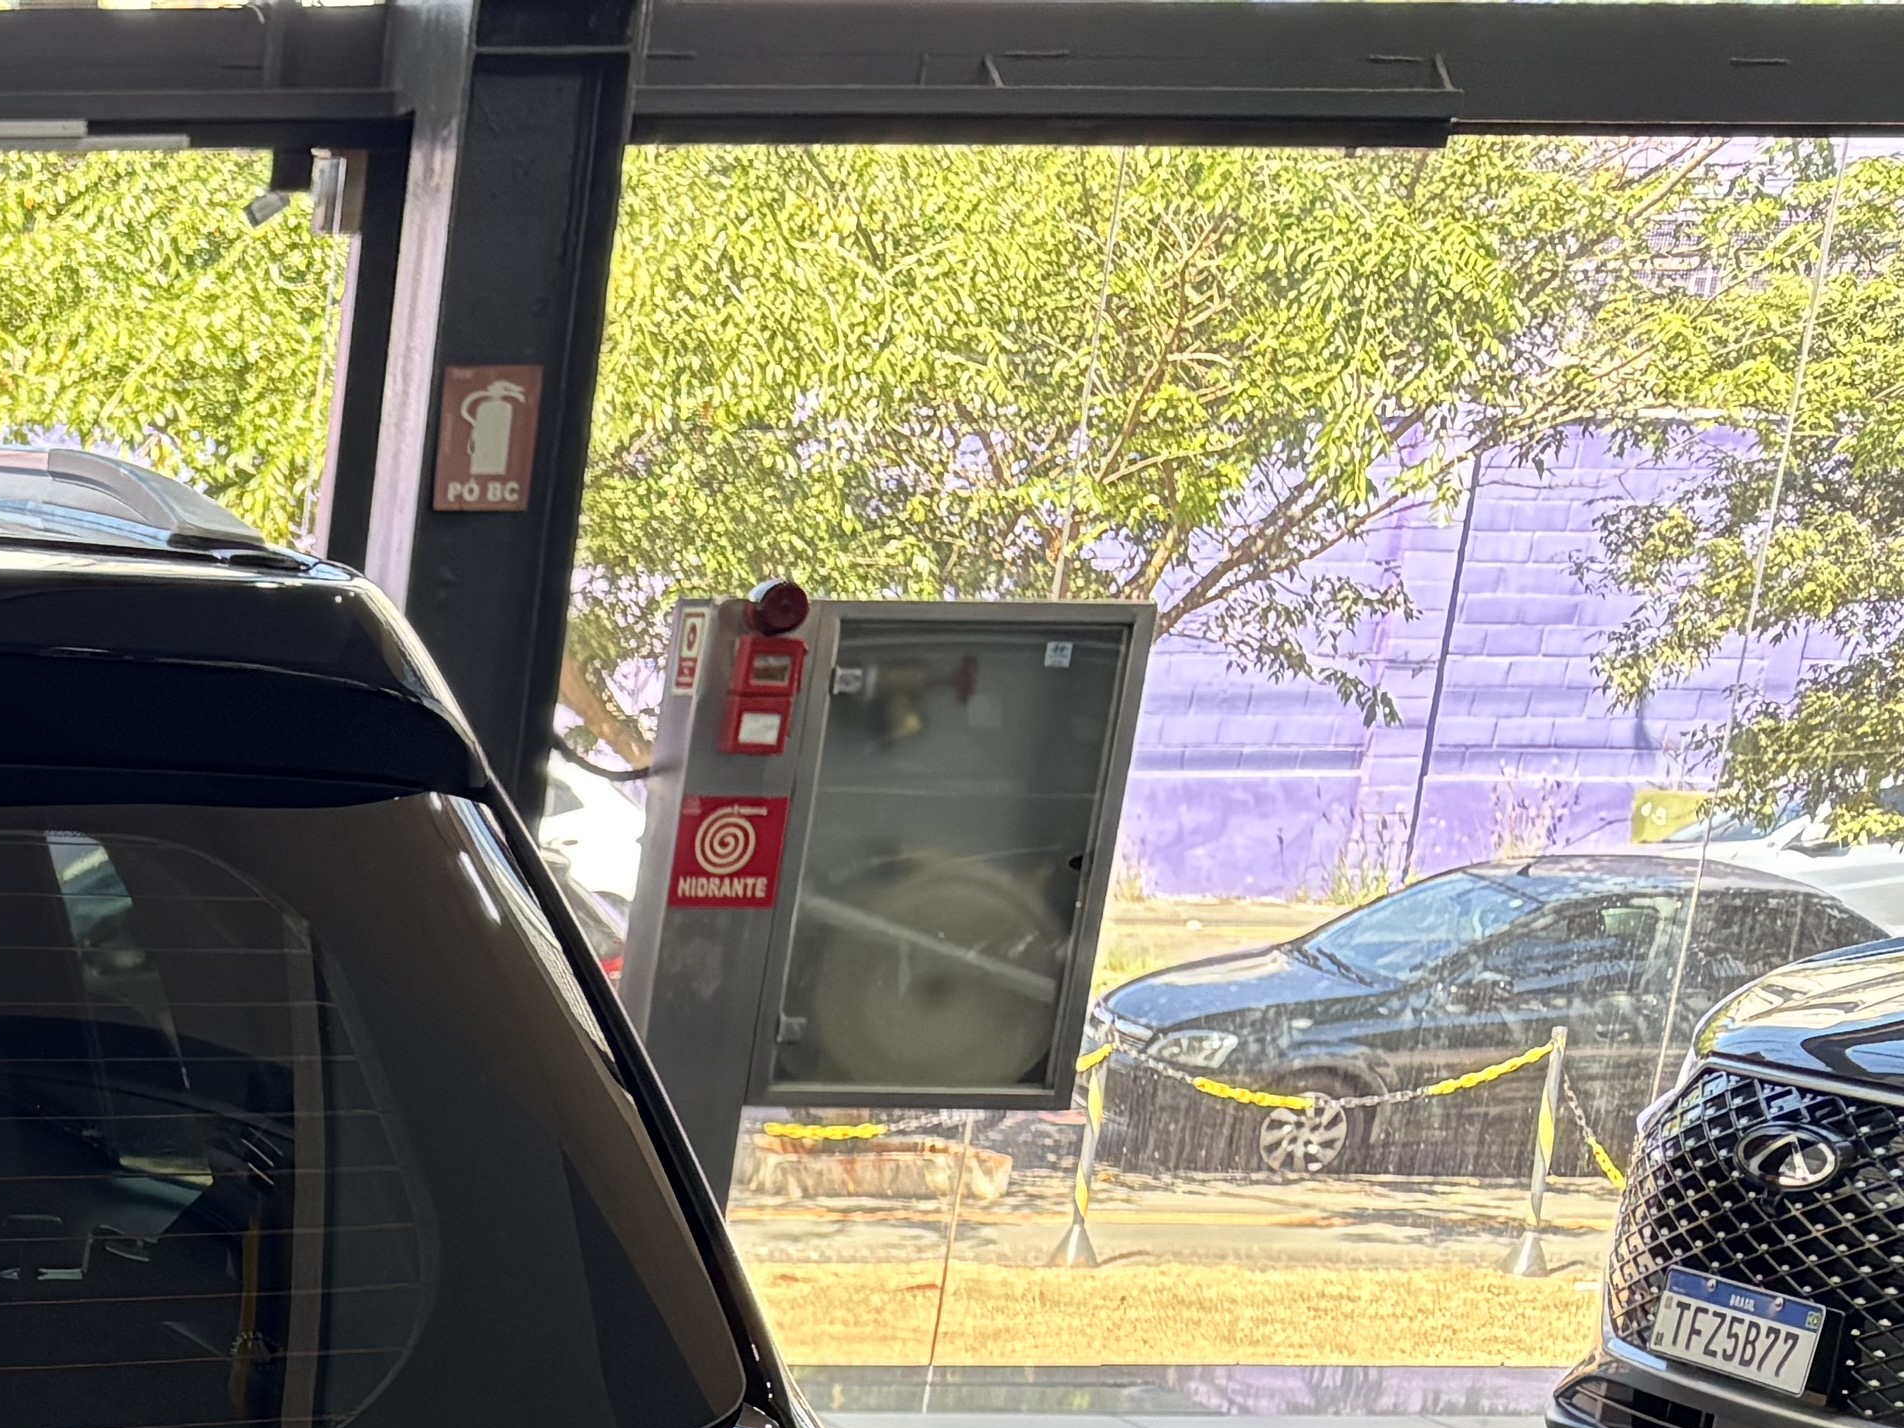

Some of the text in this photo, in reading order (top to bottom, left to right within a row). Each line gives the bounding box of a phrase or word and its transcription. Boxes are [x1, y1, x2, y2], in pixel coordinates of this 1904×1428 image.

[447, 477, 521, 503] PÓ BC
[676, 875, 769, 899] HIDRANTE
[1671, 1300, 1800, 1379] TFZ5B77
